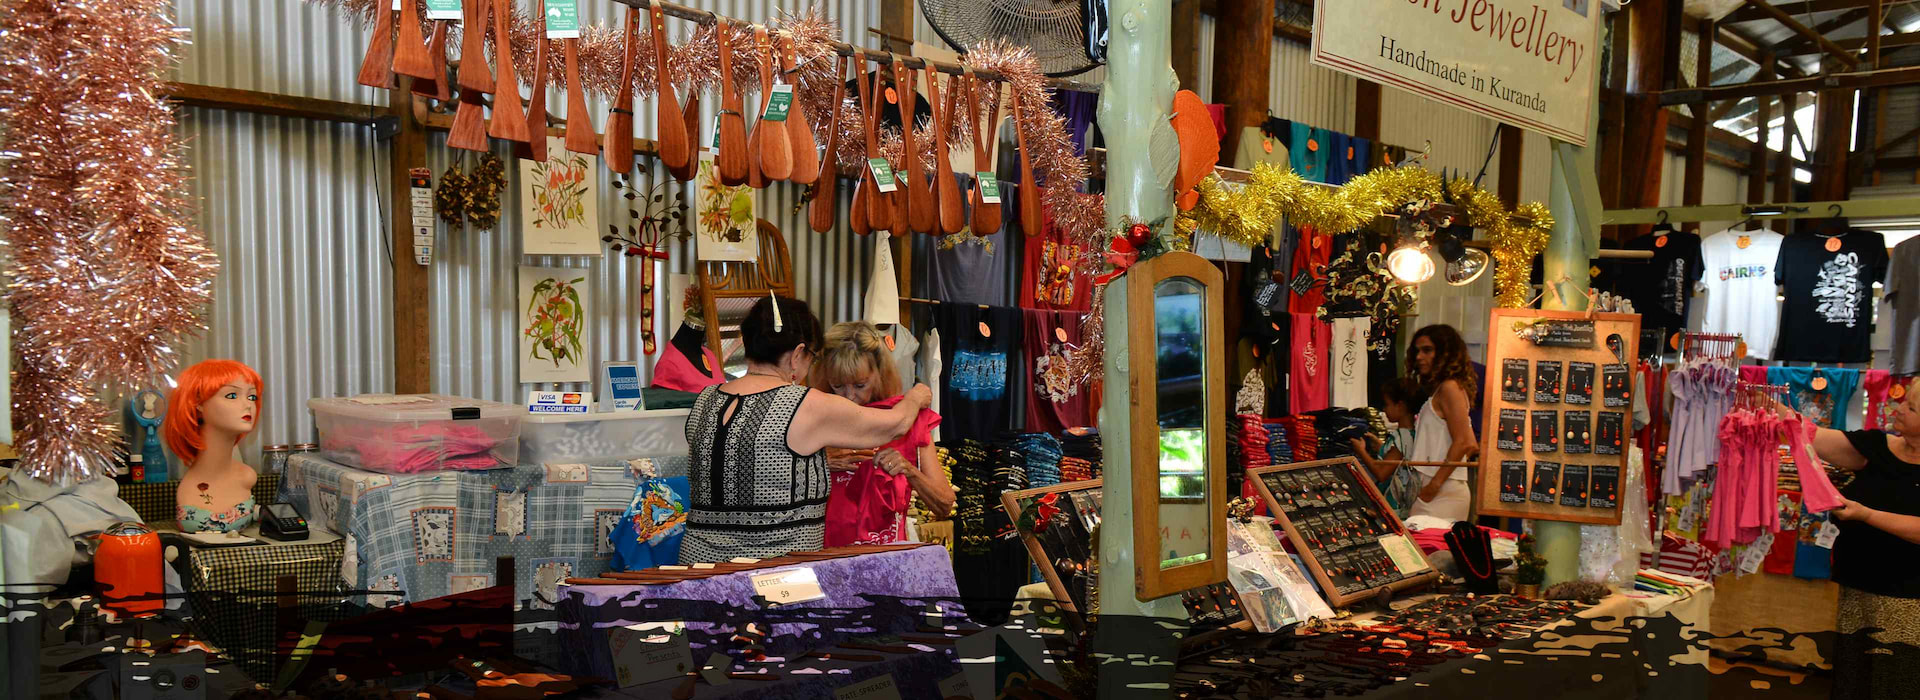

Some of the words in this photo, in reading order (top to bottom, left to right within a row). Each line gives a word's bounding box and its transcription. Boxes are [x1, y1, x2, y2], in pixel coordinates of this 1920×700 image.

[1379, 34, 1467, 86] Handmade
[1471, 69, 1485, 92] in
[1489, 76, 1547, 114] Kuranda
[532, 405, 566, 413] WELCOME
[859, 680, 893, 696] SPREADER
